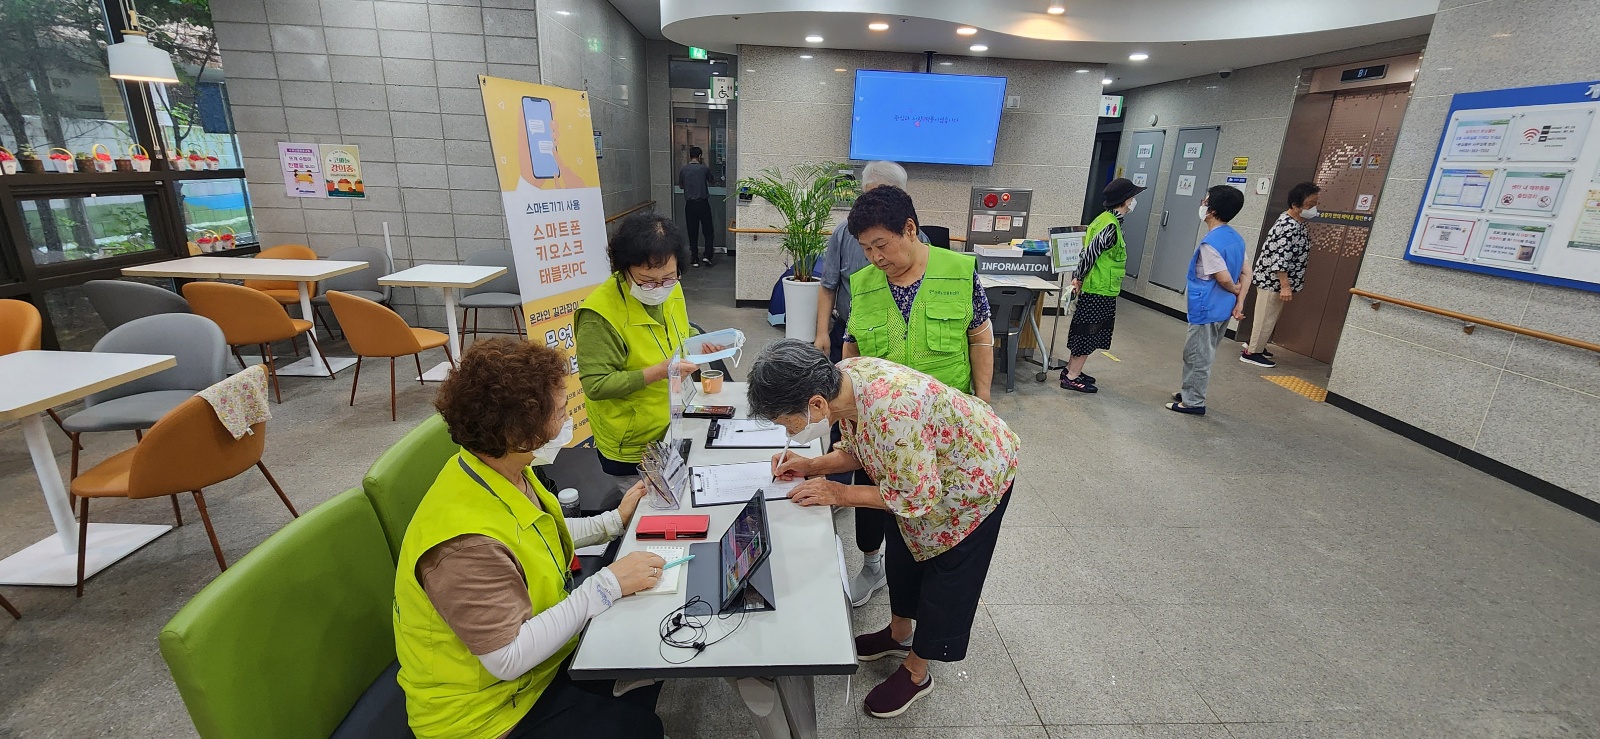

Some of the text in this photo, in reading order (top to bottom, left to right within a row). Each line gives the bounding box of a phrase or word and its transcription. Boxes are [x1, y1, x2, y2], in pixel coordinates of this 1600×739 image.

[526, 199, 581, 215] 스마트기기 사용
[533, 220, 582, 241] 스마트폰
[536, 240, 585, 261] 키오스크
[539, 261, 588, 284] 태블릿PC
[981, 261, 1050, 272] INFORMATION
[529, 301, 579, 325] 온라인 길라잡이
